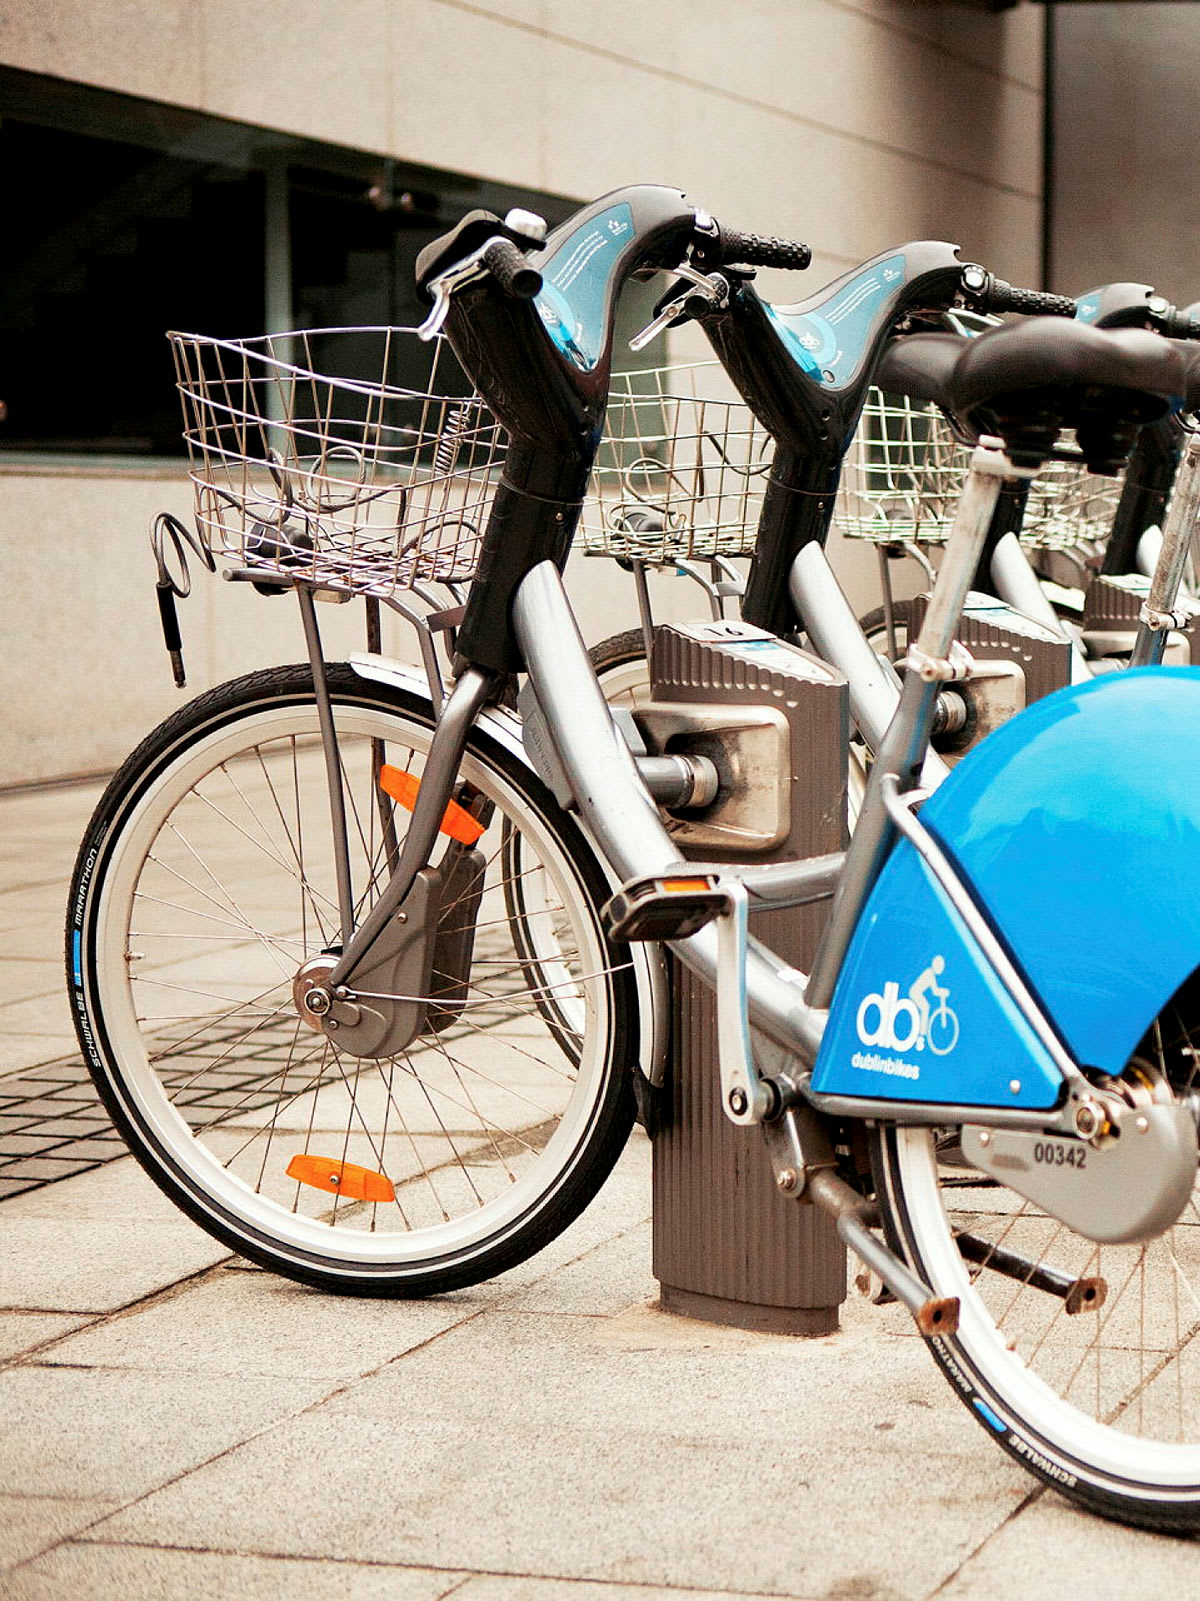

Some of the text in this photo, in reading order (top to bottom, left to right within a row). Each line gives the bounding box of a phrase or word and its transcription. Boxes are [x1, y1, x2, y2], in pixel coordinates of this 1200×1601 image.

[75, 848, 101, 1067] SCHWALBE MARATHON
[851, 1052, 920, 1080] dublinbikes
[1034, 1142, 1087, 1169] 00342
